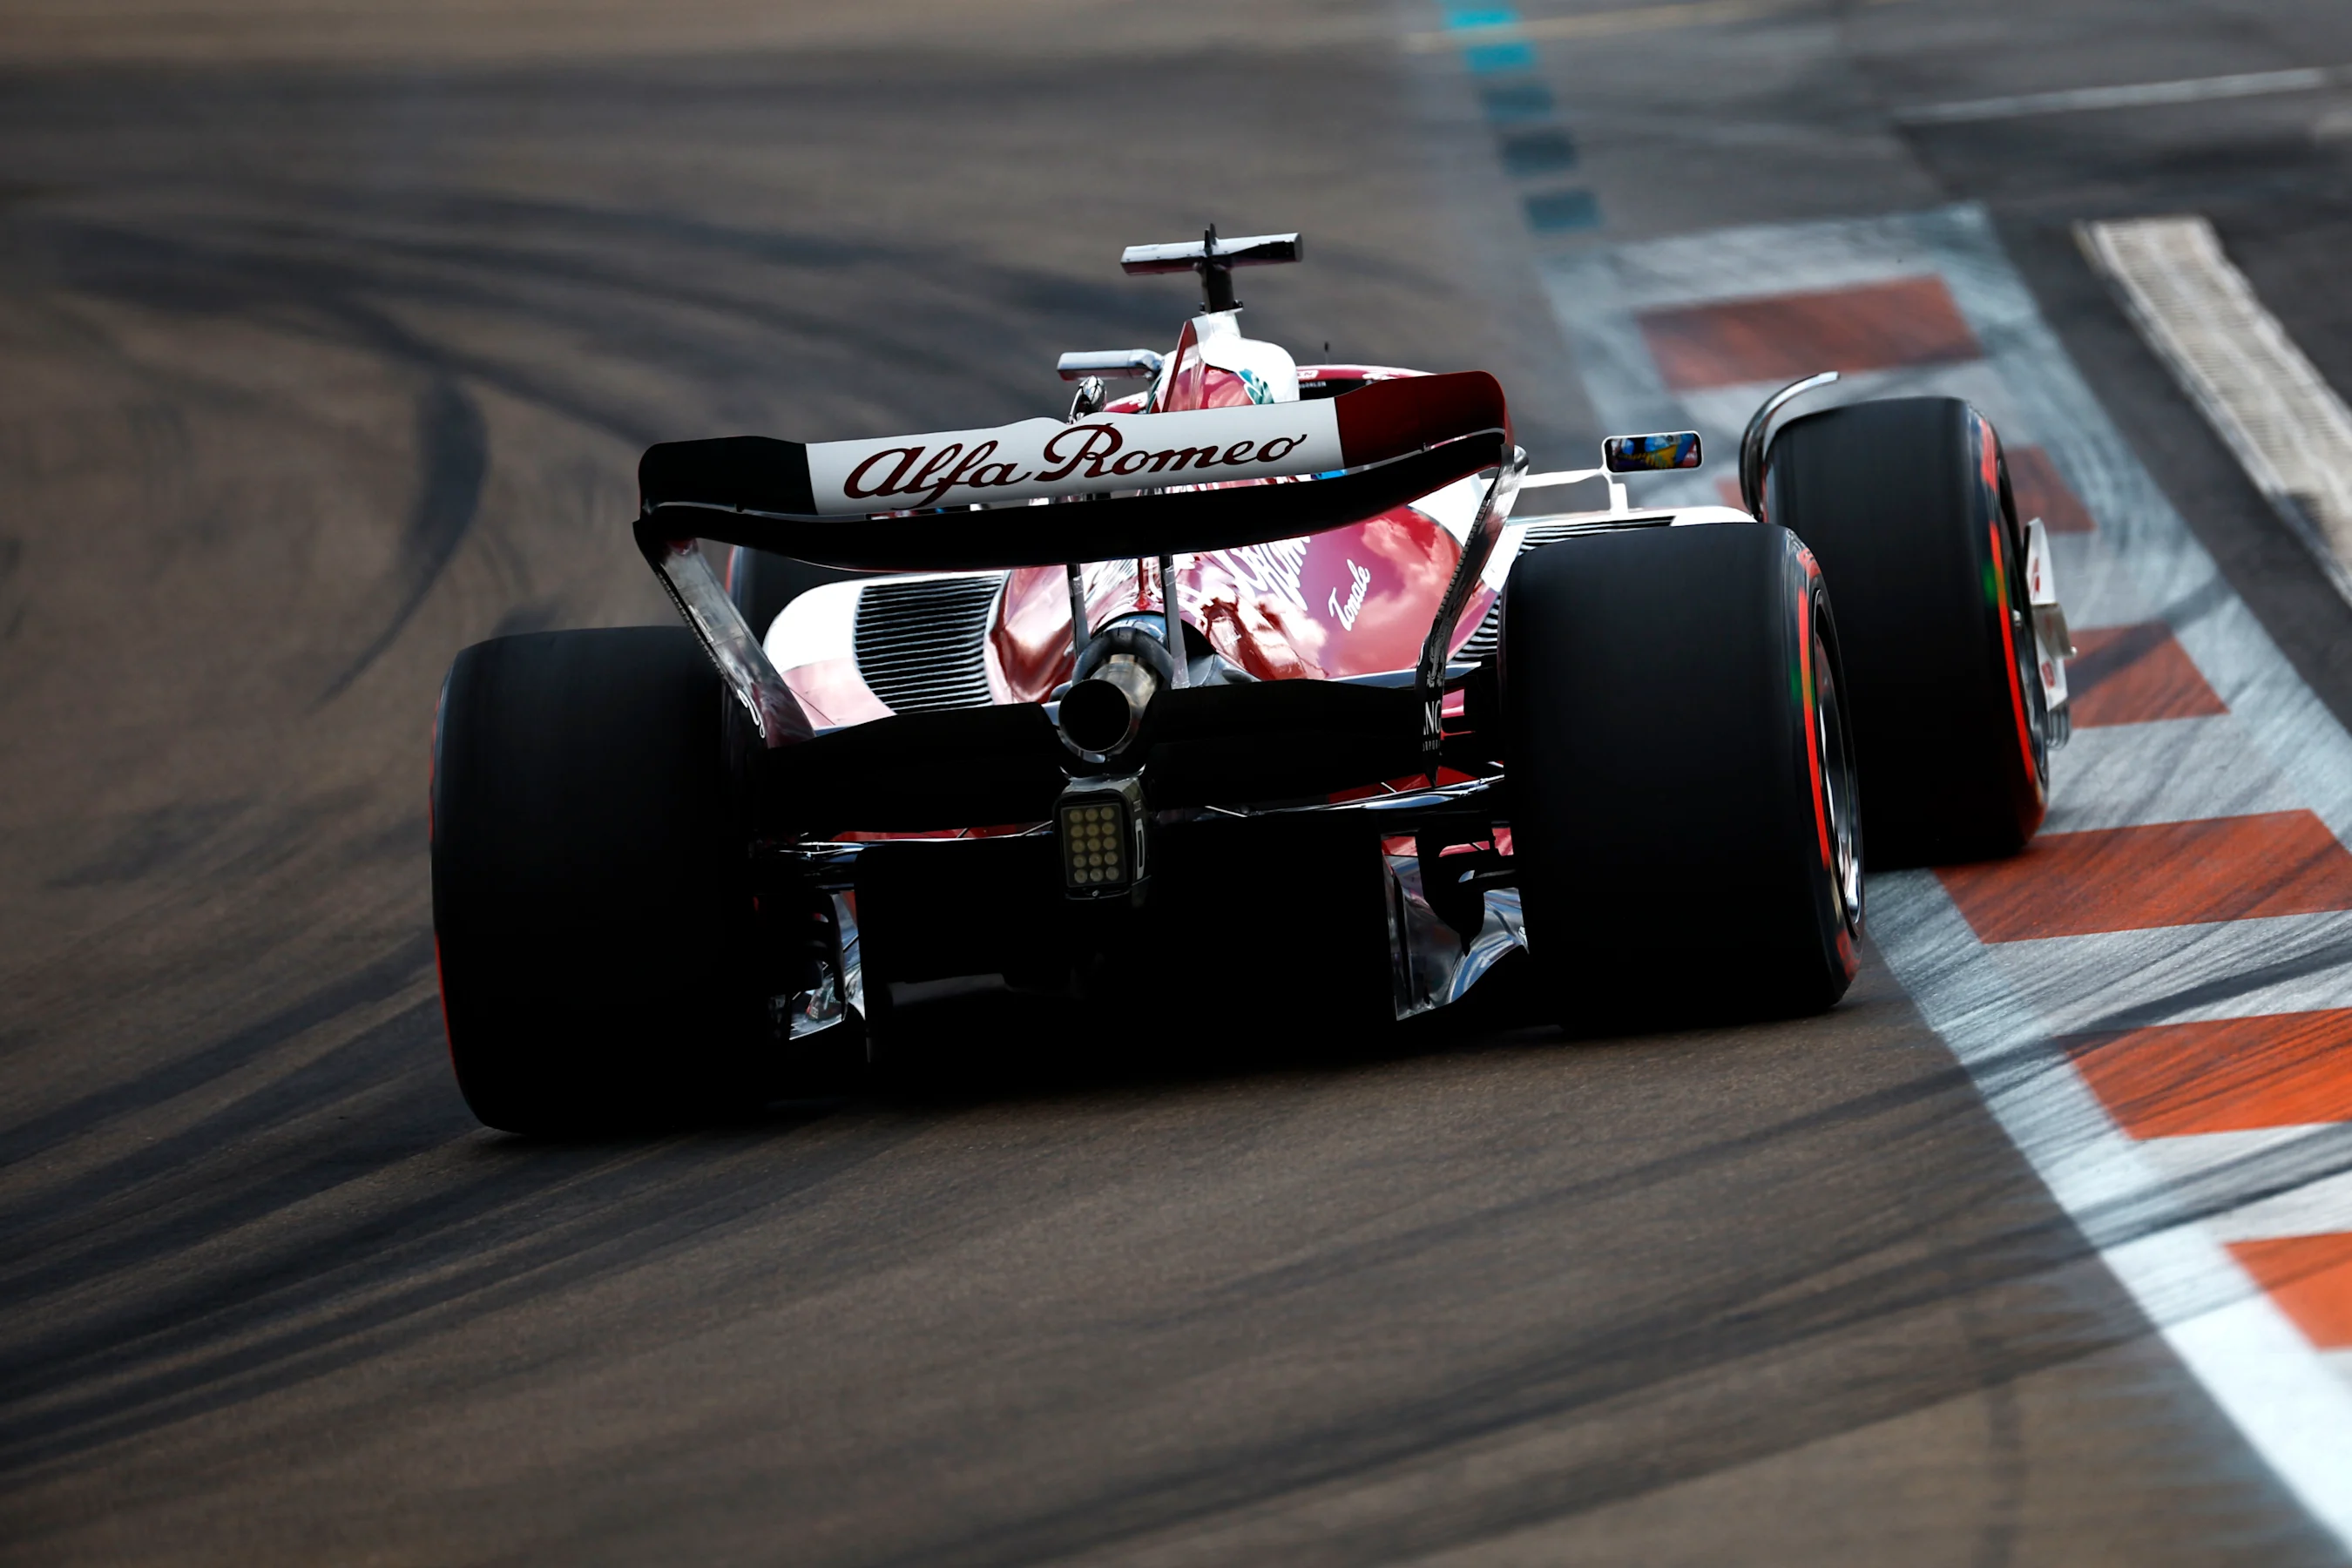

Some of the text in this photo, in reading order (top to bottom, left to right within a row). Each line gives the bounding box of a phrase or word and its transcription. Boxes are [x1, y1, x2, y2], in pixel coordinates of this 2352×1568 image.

[843, 422, 1308, 510] Alfa Romeo
[1328, 558, 1371, 632] Tonale
